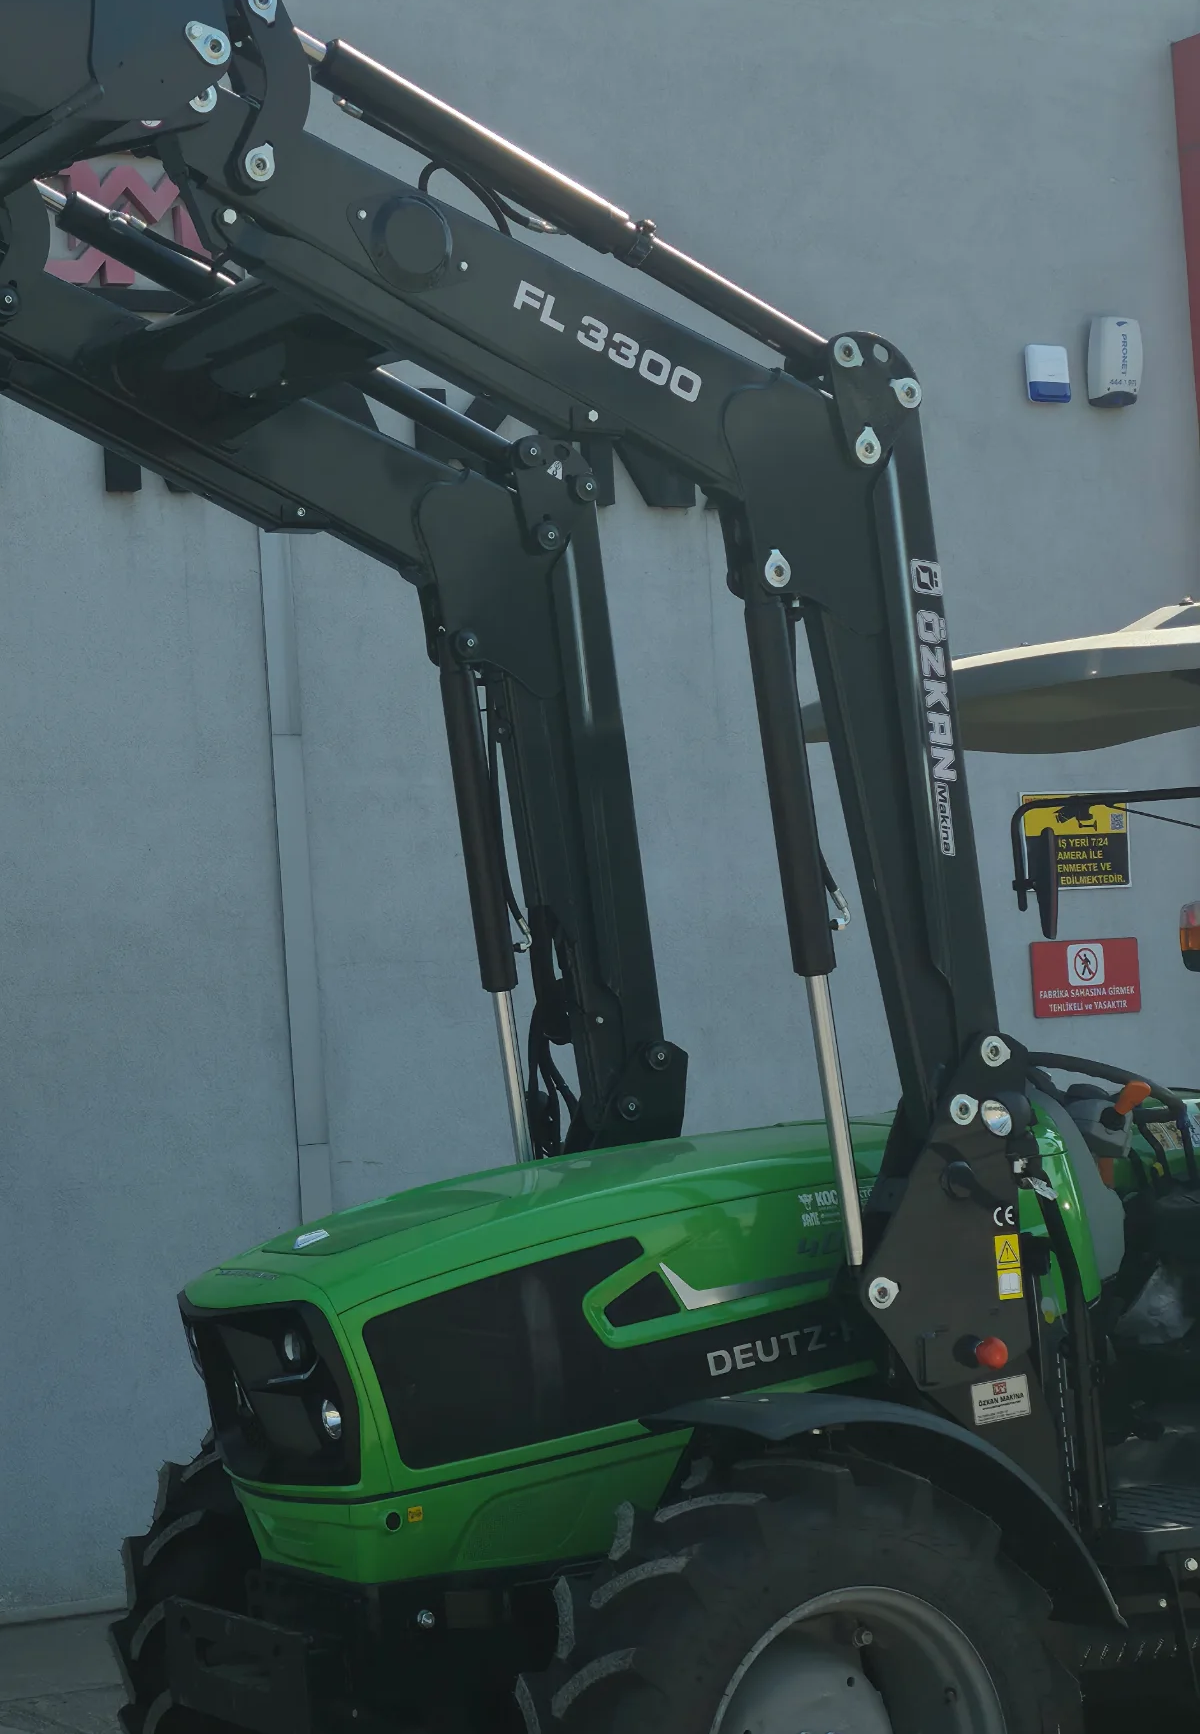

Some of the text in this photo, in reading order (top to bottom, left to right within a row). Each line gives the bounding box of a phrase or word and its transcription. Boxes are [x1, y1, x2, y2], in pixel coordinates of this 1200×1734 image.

[513, 280, 702, 403] FL 3300
[916, 609, 957, 782] ÖZKAN
[937, 785, 951, 852] Makina
[1069, 836, 1089, 847] YERİ
[1057, 849, 1103, 861] AMERA İLE
[1057, 862, 1112, 873] ENMEKTE VE
[1040, 988, 1069, 999] FABRİKA
[1108, 985, 1135, 996] GİRMEK
[993, 1205, 1015, 1227] CE
